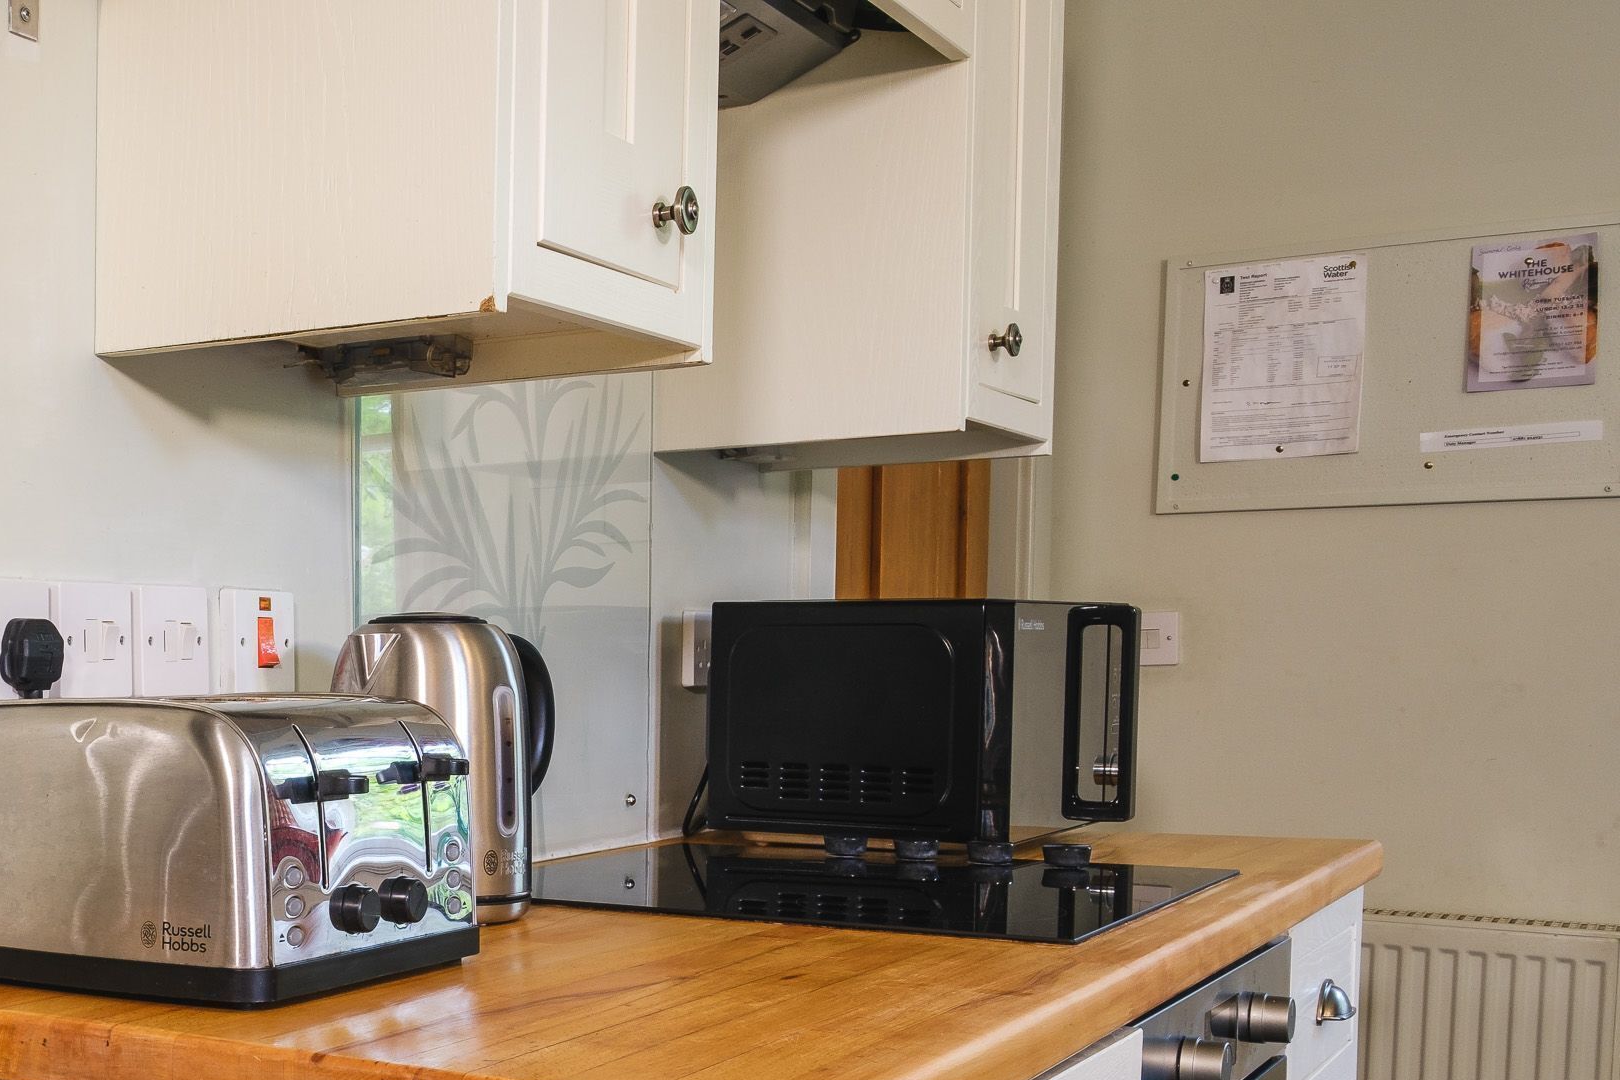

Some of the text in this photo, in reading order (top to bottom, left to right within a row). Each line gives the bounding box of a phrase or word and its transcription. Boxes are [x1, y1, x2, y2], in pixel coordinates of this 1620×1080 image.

[1323, 270, 1348, 278] Water
[1498, 264, 1574, 279] WHITEHOUSE
[162, 921, 212, 939] Russell
[161, 936, 207, 953] Hobbs
